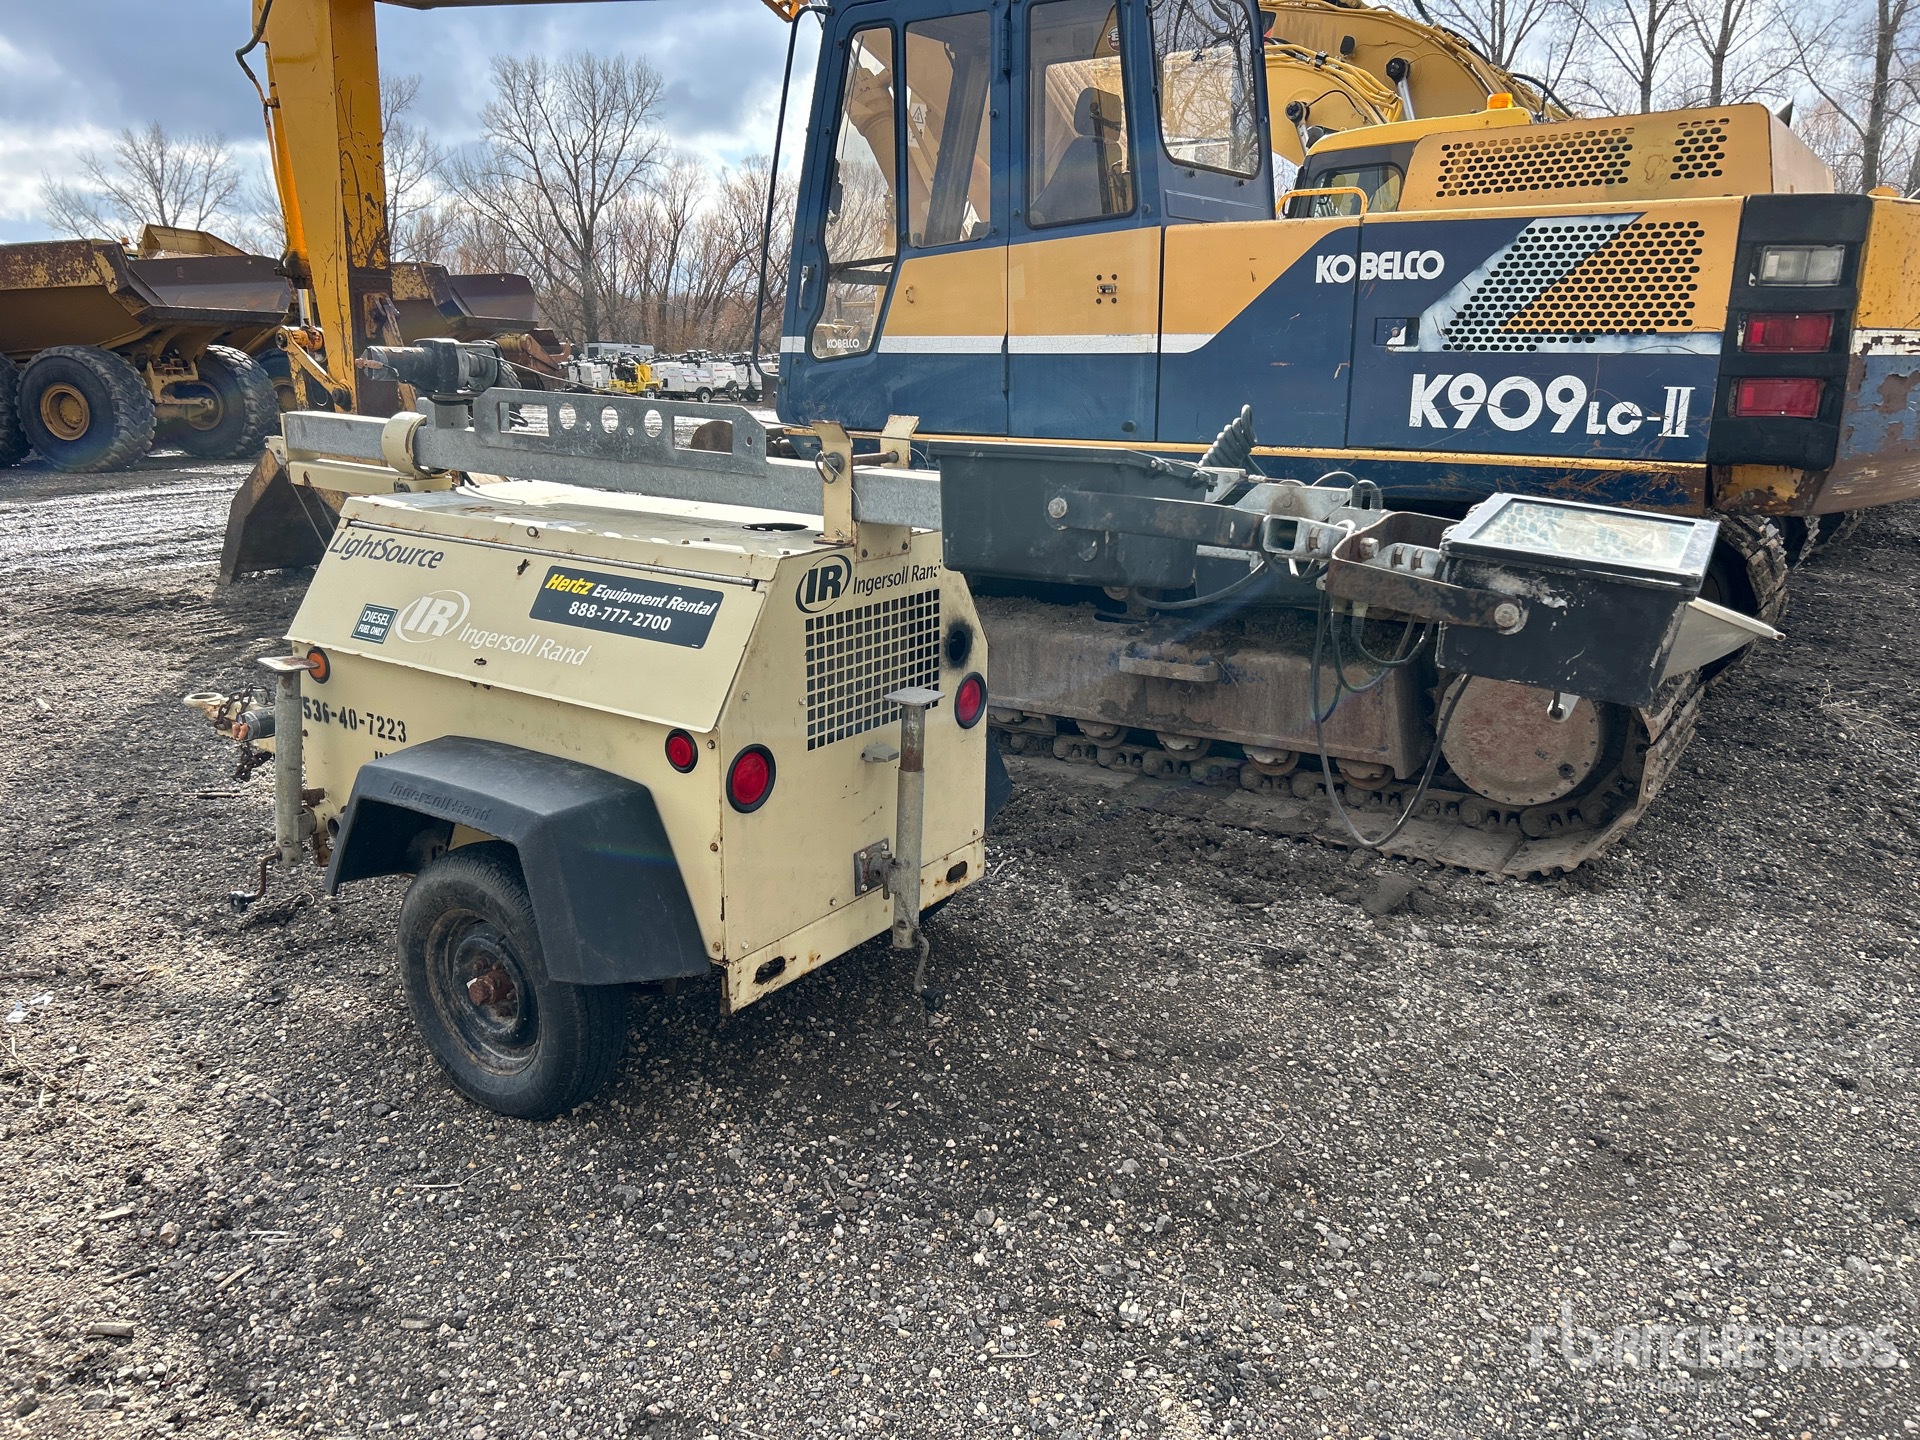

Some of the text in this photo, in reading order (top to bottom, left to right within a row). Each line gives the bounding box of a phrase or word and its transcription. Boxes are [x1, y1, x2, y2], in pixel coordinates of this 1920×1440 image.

[1315, 250, 1445, 283] KOBELCO
[826, 338, 860, 349] KOBELCO
[329, 531, 444, 569] LightSource
[545, 574, 718, 616] Hertz Equipment Rental
[853, 565, 909, 597] Ingersoll
[357, 623, 386, 637] FUEL ONLY
[362, 610, 390, 626] DIESEL
[402, 595, 460, 637] IR
[568, 601, 672, 632] 888-777-2700
[457, 622, 593, 666] Ingersoll Rand
[388, 781, 453, 811] Ingersoll
